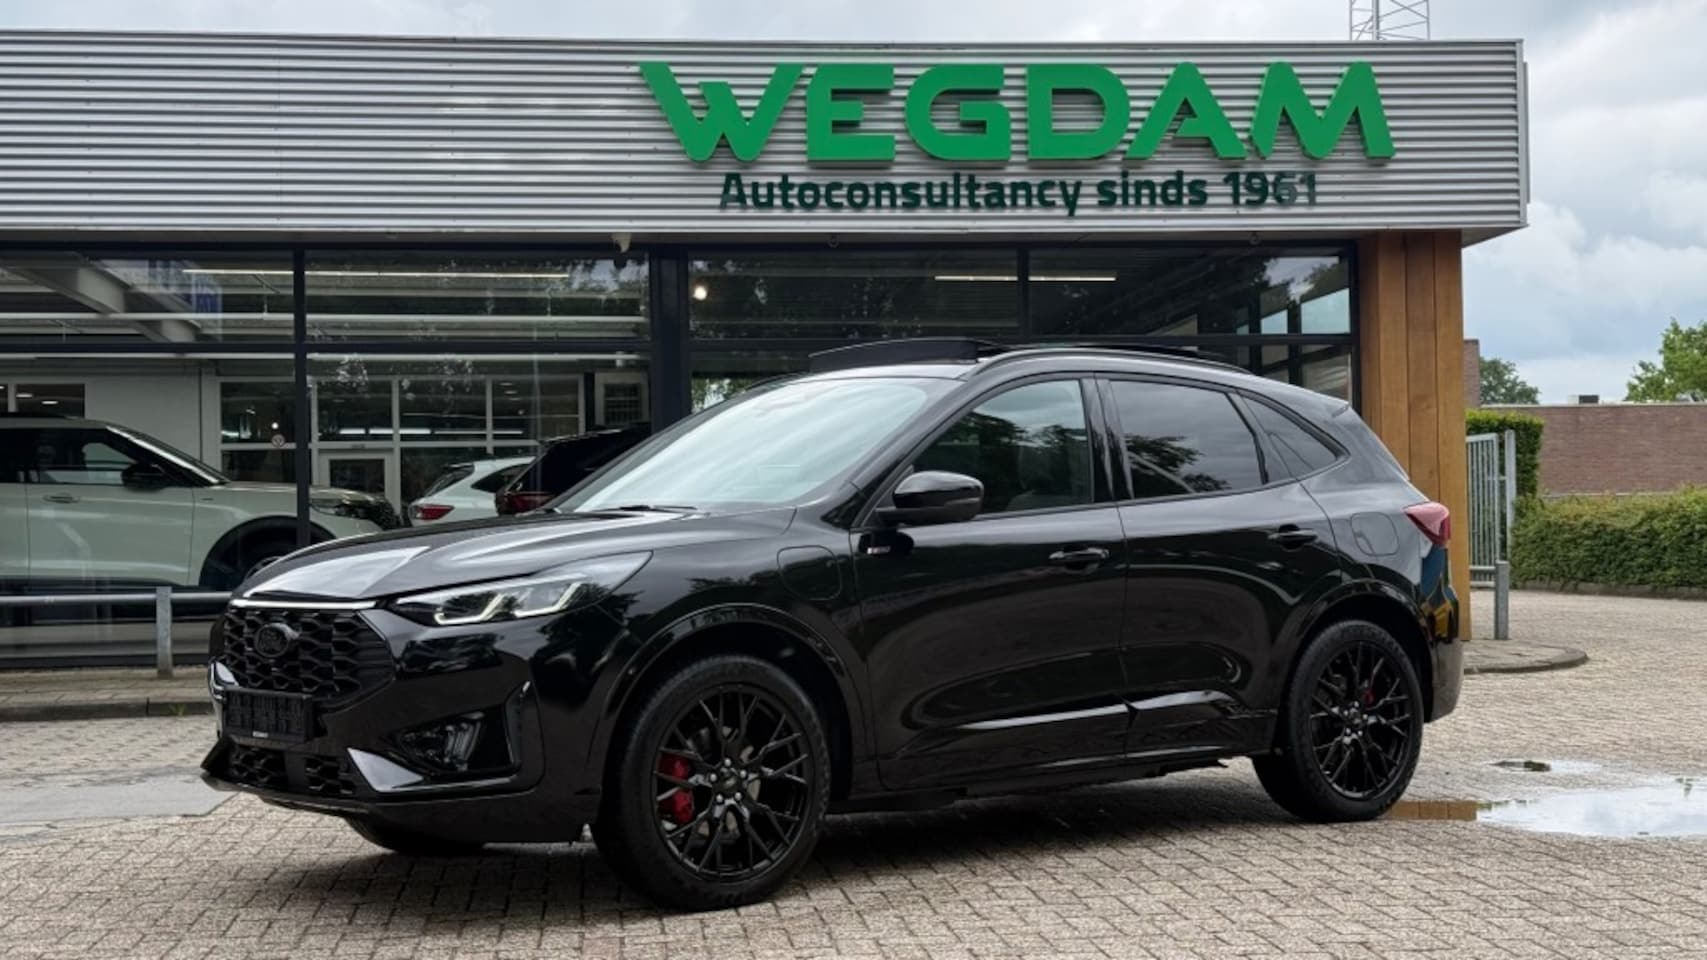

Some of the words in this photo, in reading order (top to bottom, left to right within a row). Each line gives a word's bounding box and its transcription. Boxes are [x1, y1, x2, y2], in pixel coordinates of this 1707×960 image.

[639, 61, 1395, 163] WEGDAM
[720, 172, 1081, 216] Autoconsultancy
[1096, 170, 1208, 207] sinds
[1222, 171, 1317, 206] 1961
